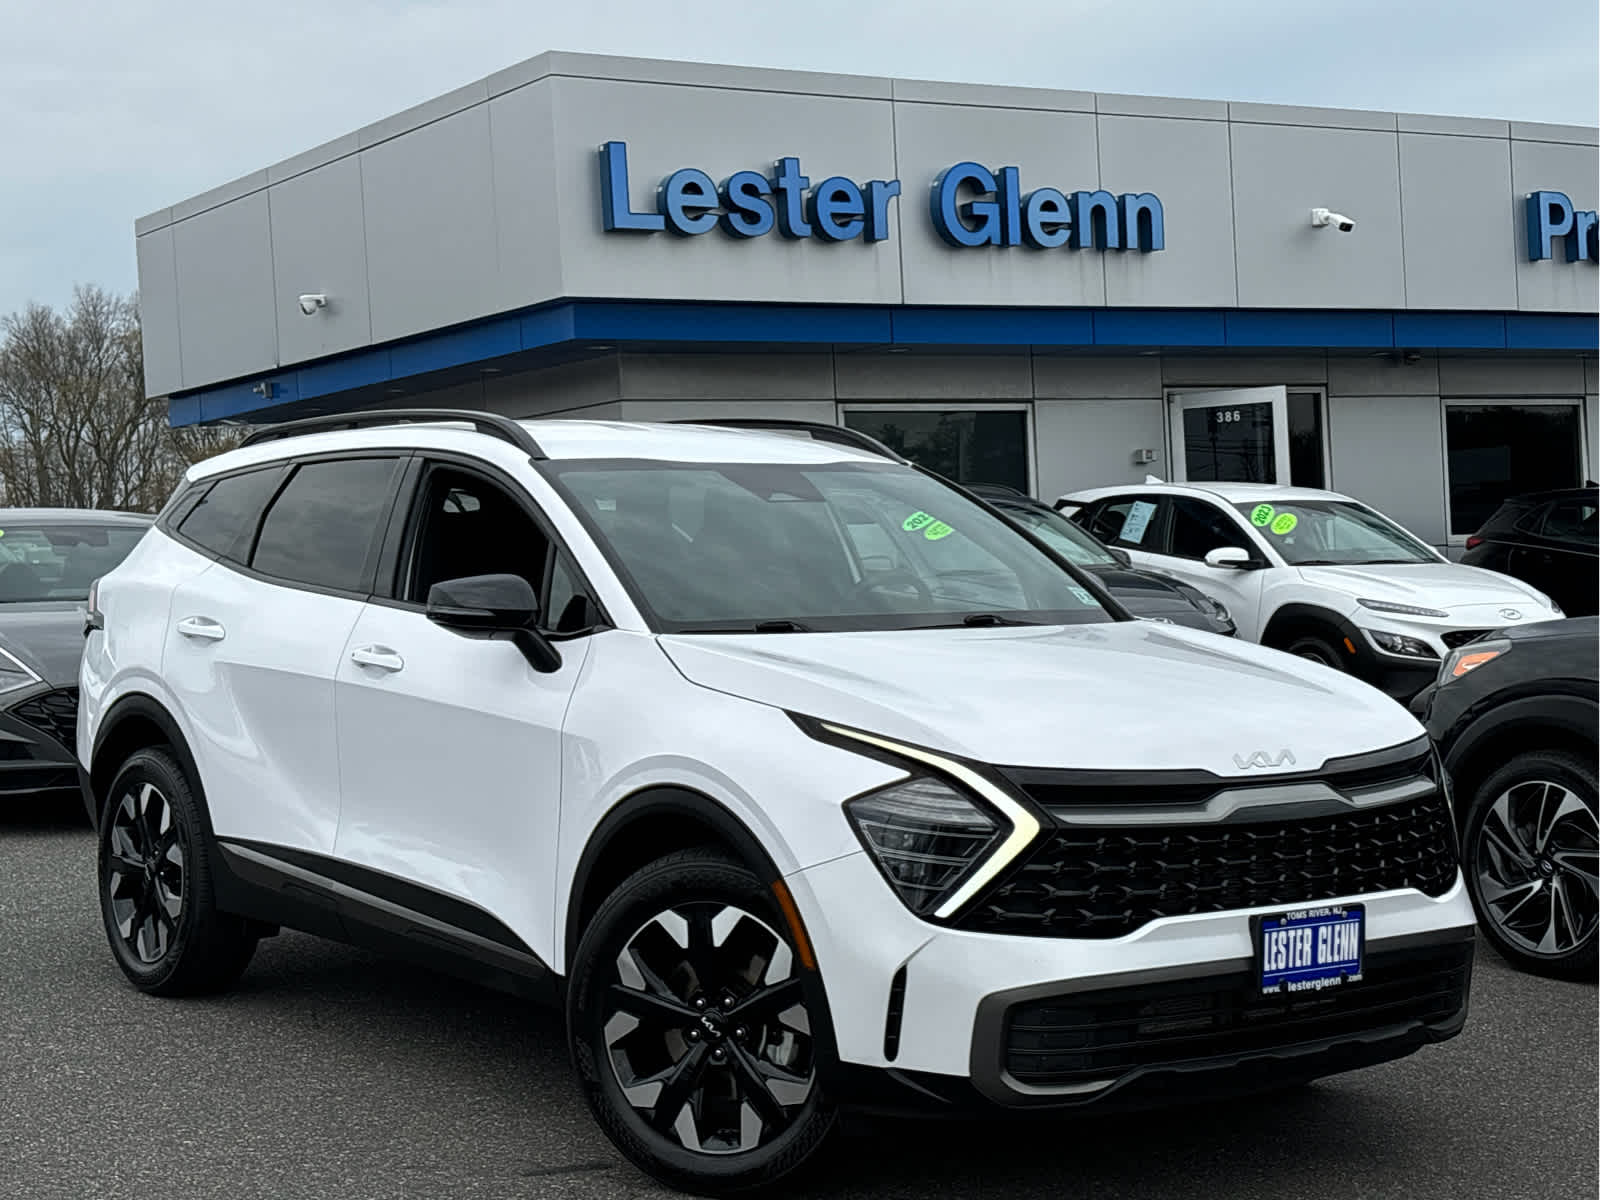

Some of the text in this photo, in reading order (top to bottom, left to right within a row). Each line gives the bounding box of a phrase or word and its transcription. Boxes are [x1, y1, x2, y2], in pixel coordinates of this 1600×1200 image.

[600, 141, 1164, 251] Lester Glenn
[1527, 191, 1599, 263] Pr
[1216, 410, 1240, 423] 386
[1286, 910, 1307, 920] TOMS
[1263, 922, 1359, 972] LESTER GLENN
[1287, 976, 1341, 992] lesterglenn
